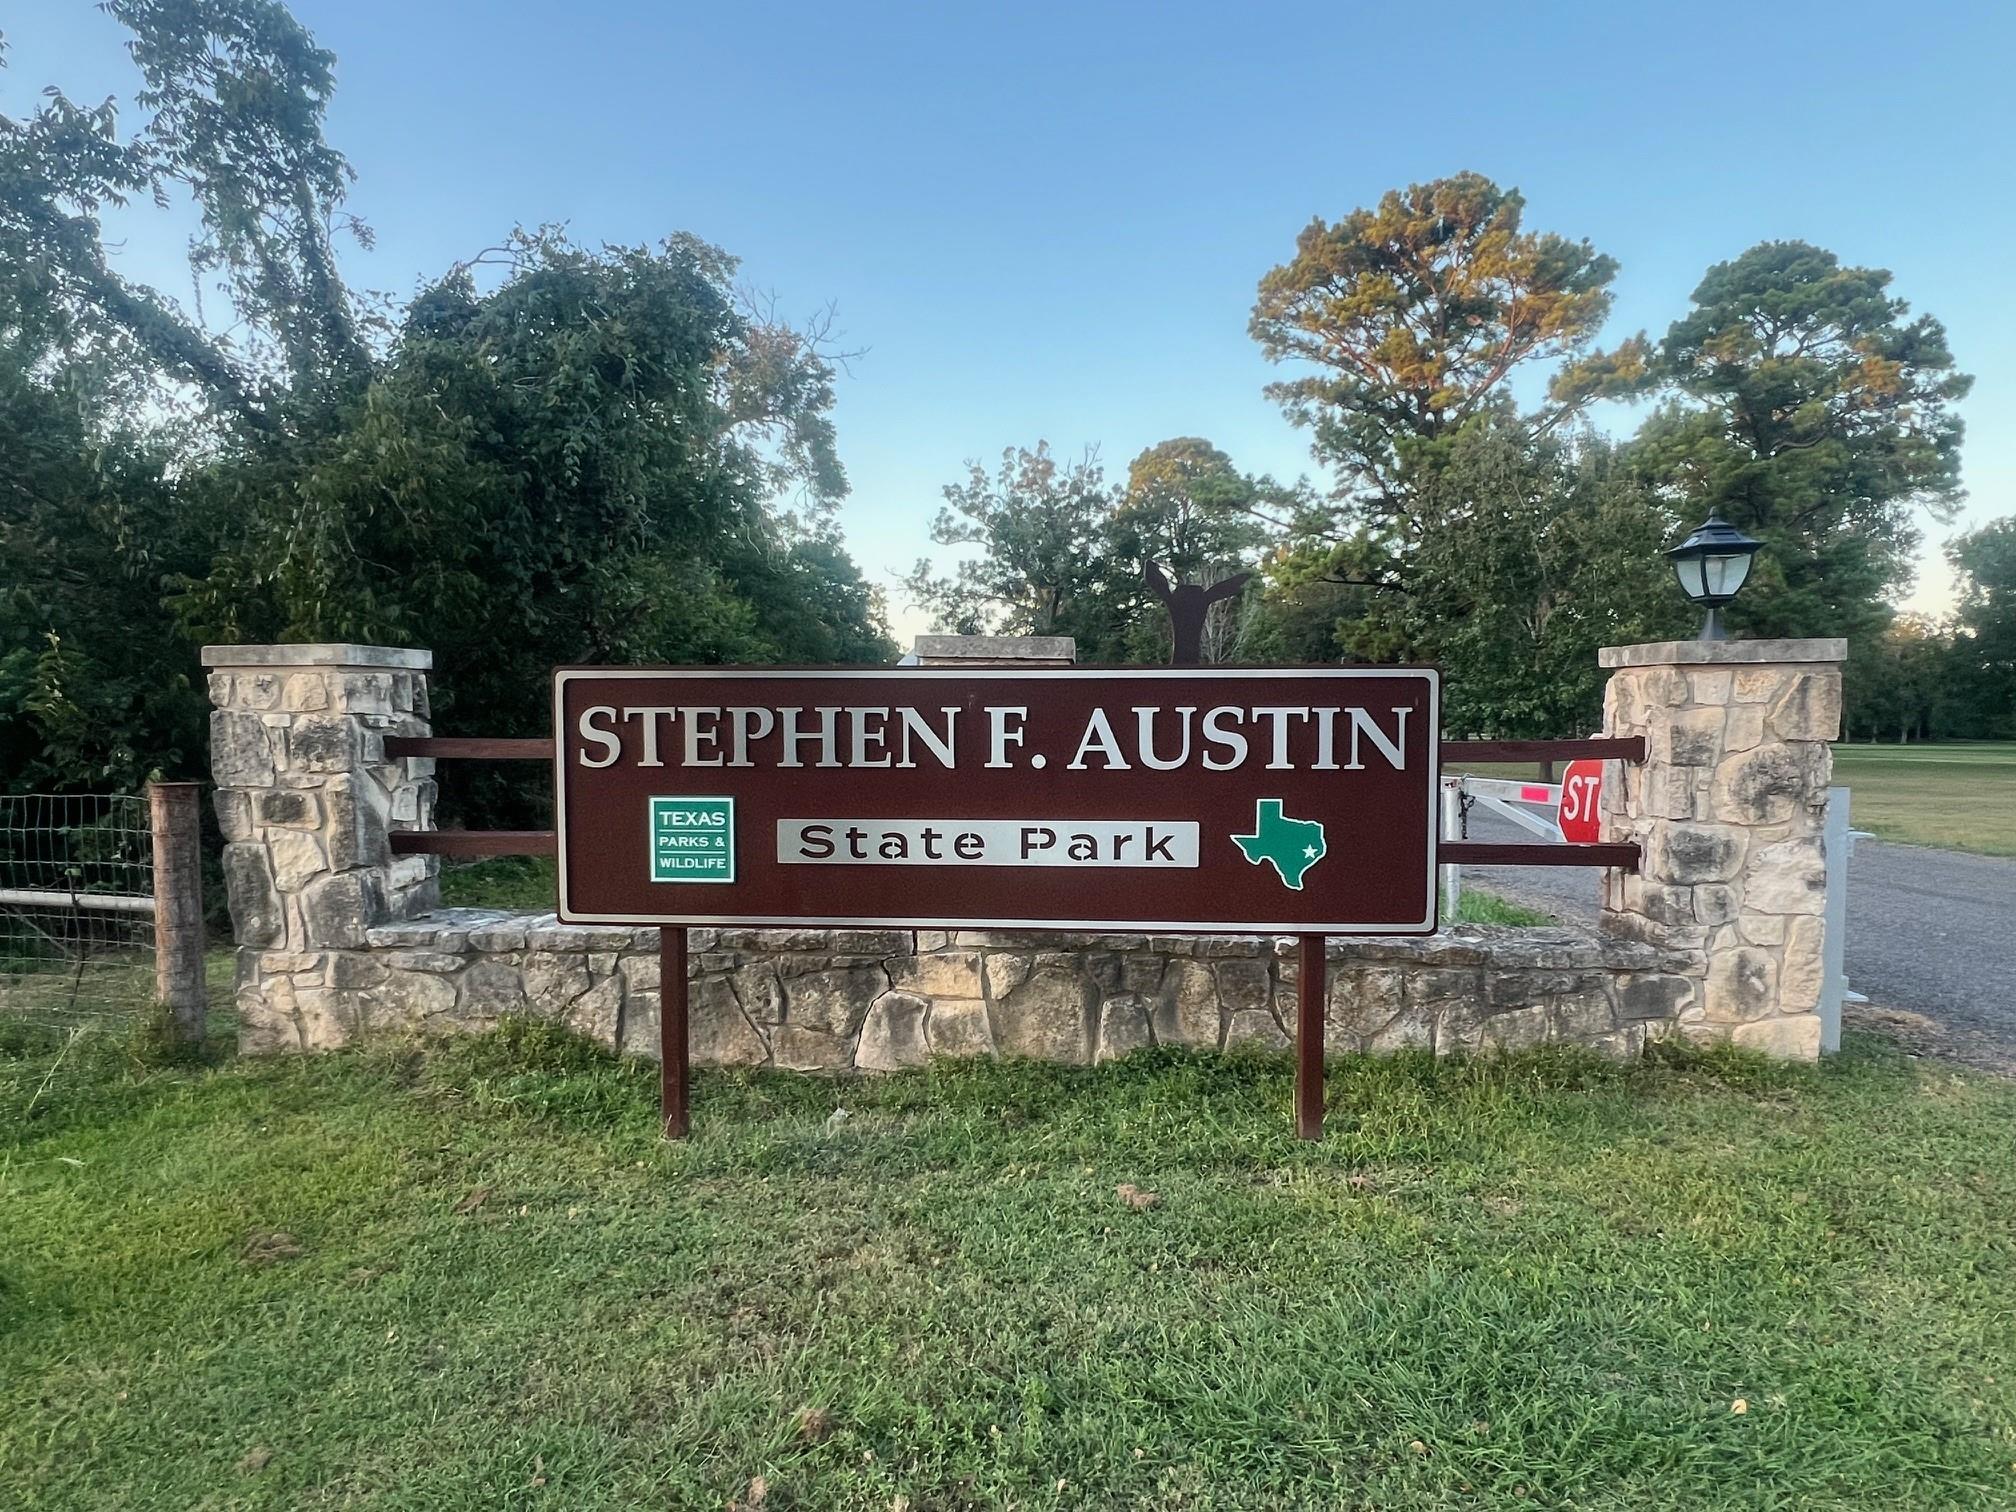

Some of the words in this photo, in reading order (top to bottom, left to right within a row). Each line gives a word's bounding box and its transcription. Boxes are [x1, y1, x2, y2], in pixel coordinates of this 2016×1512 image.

[578, 705, 962, 769] STEPHEN
[983, 705, 1047, 770] F.
[1066, 705, 1413, 770] AUSTIN
[1563, 774, 1602, 822] ST
[658, 811, 726, 826] TEXAS
[659, 836, 710, 848] PARKS
[714, 836, 726, 848] &
[799, 824, 986, 860] State
[1020, 826, 1176, 862] Park
[659, 857, 727, 869] WILDLIFE
